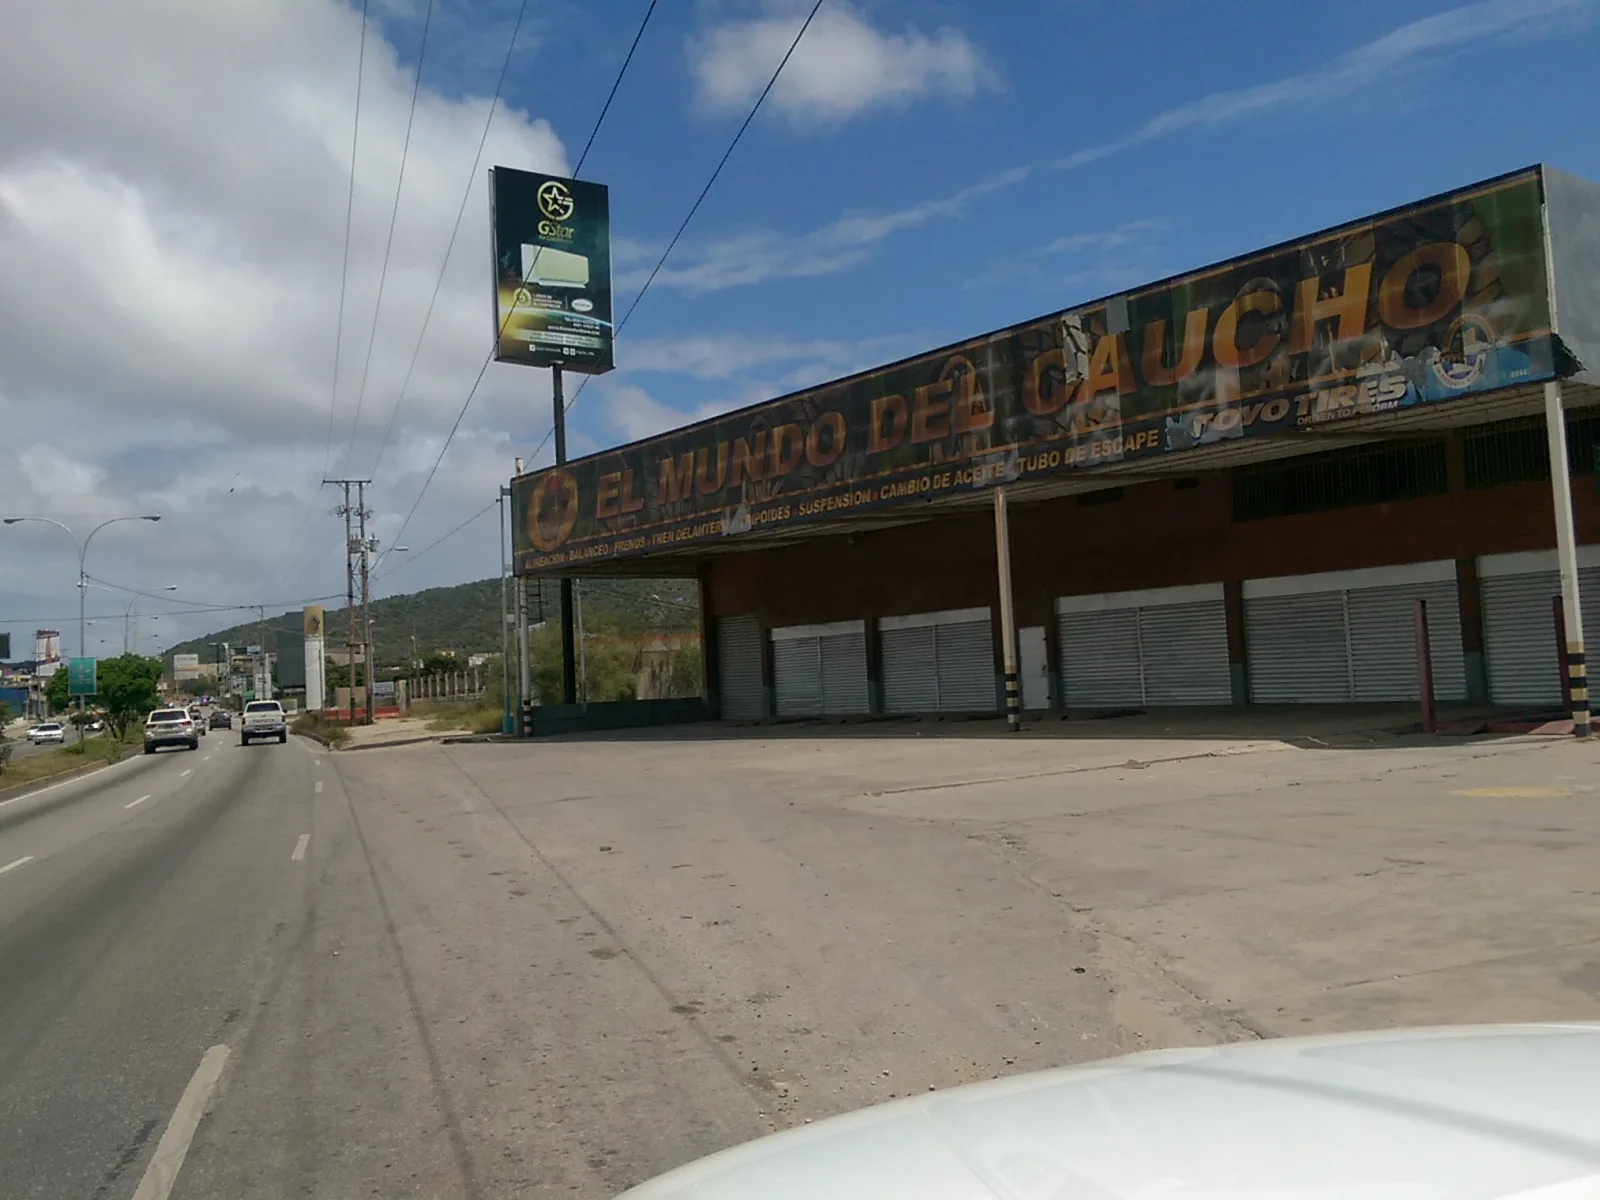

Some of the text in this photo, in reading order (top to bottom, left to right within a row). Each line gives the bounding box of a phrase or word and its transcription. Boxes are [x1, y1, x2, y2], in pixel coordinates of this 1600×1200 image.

[596, 469, 644, 519] EL
[658, 411, 846, 504] MUNDO
[867, 373, 995, 455] DEL
[1023, 242, 1471, 415] CAUCHO
[1192, 375, 1406, 438] TOYO TIRES
[524, 553, 565, 570] ALINEACION
[570, 544, 609, 562] BALANCEO
[615, 537, 646, 554] FRENOS
[652, 531, 674, 545] TREN
[798, 490, 871, 516] SUSPENSION
[881, 476, 929, 500] CAMBIO
[933, 473, 950, 489] DE
[954, 461, 1005, 486] ACEITE
[1018, 451, 1060, 472] TUBO
[1065, 447, 1086, 465] DE
[1091, 428, 1159, 459] ESCAPE
